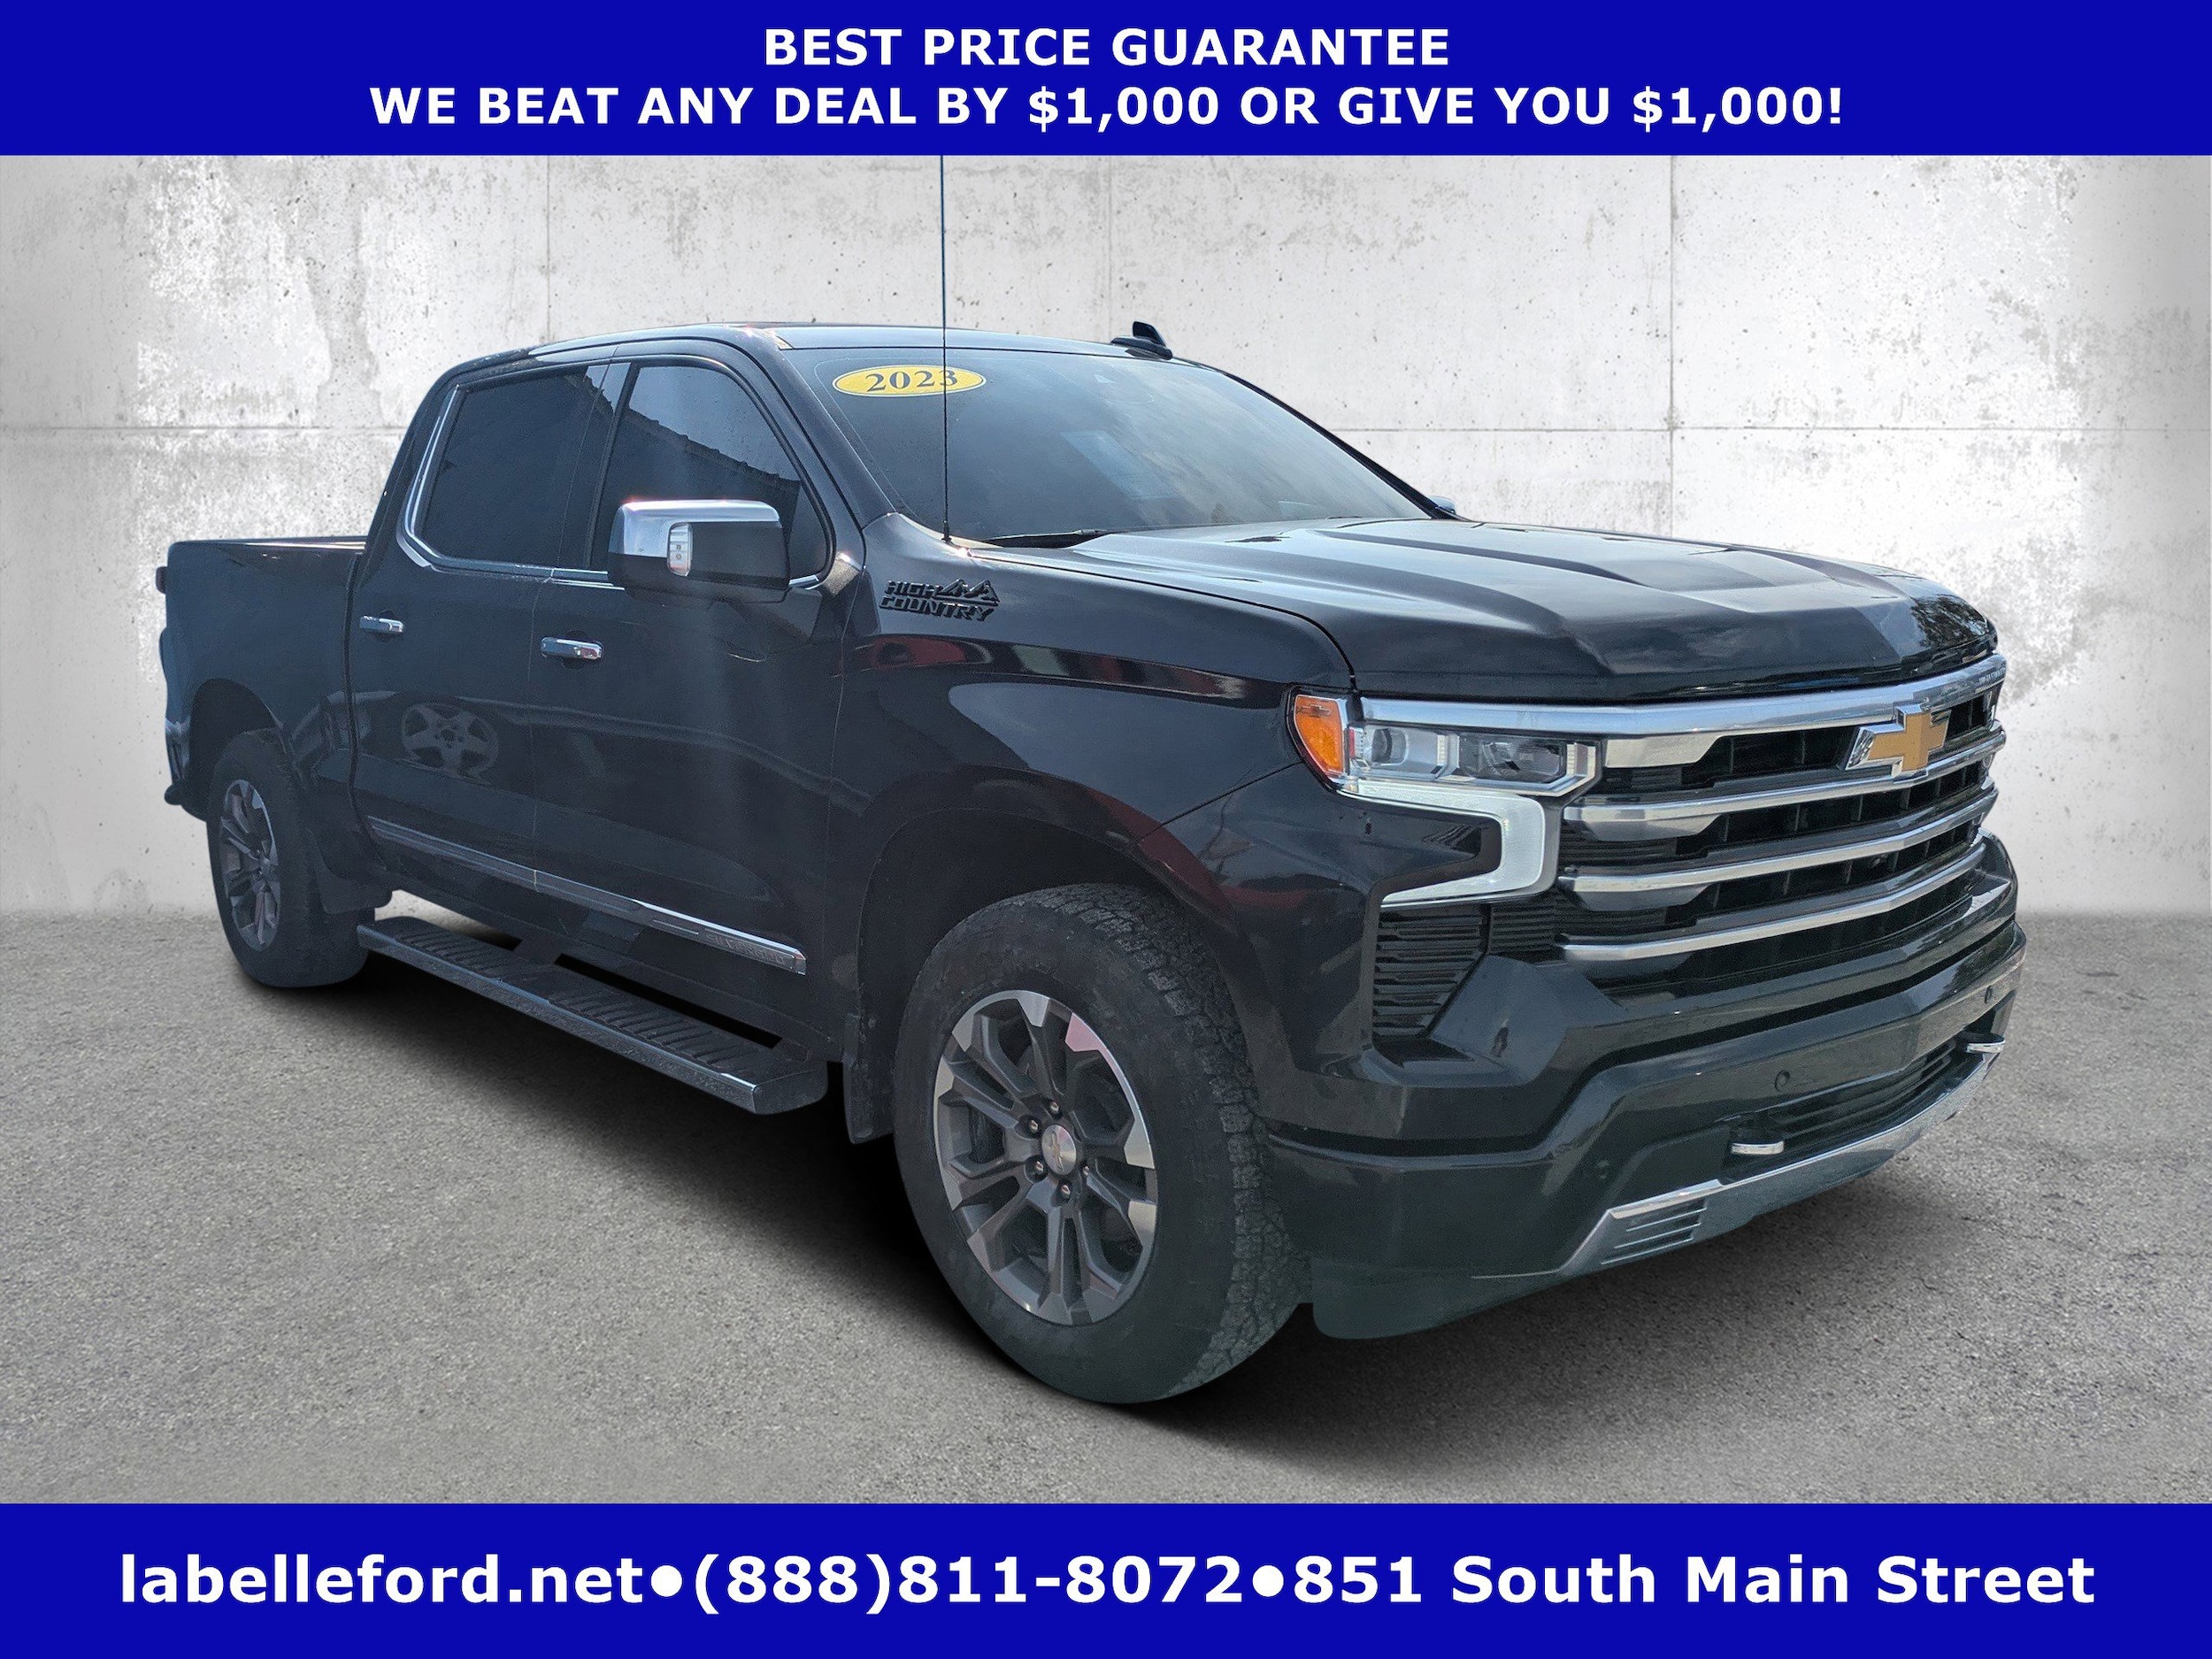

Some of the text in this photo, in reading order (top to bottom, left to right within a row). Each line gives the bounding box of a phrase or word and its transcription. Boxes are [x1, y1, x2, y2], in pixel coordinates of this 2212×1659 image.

[865, 370, 958, 392] 2023
[885, 580, 943, 599] HIGH
[879, 595, 995, 622] COUNTRY
